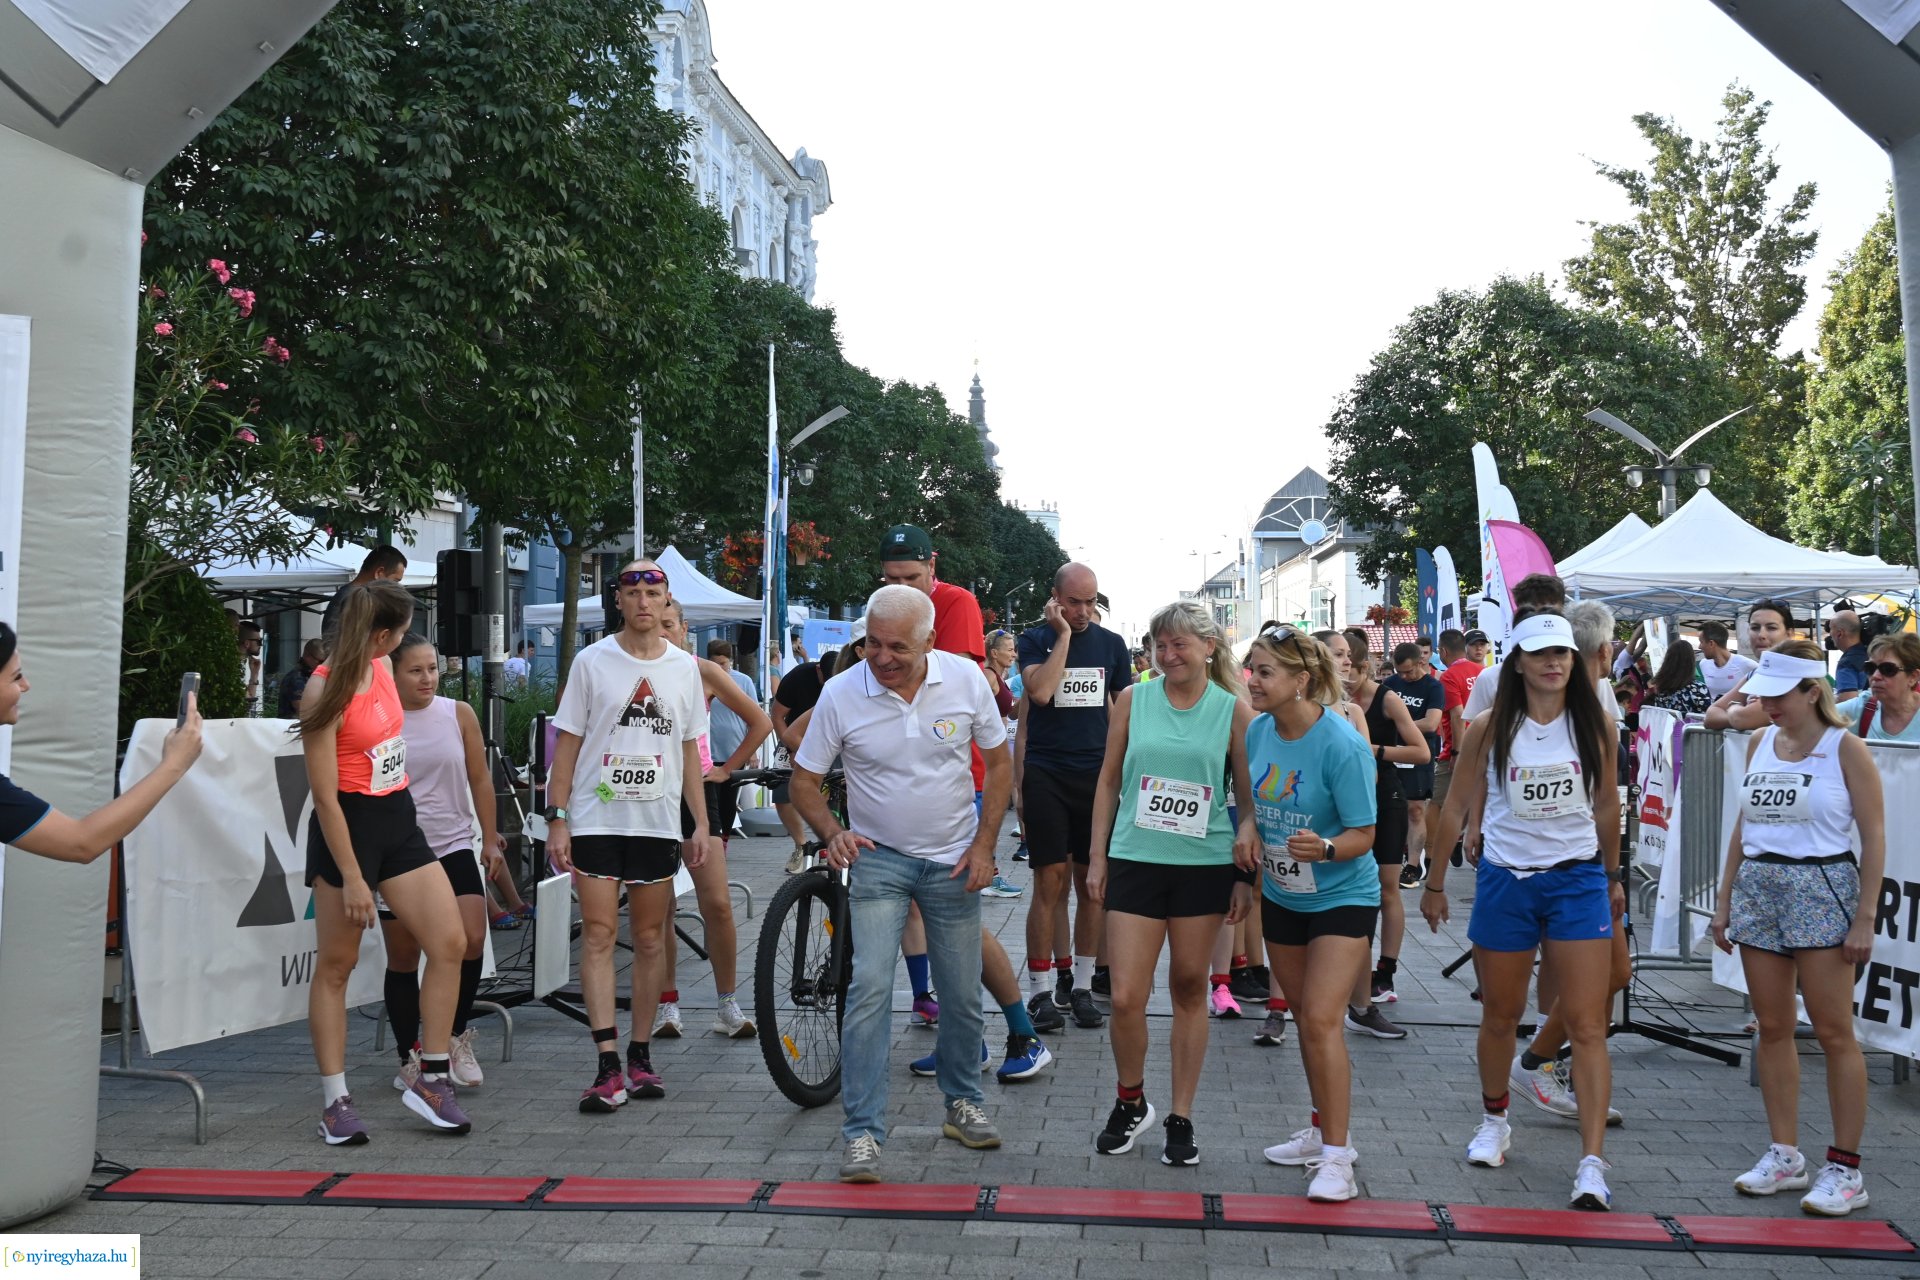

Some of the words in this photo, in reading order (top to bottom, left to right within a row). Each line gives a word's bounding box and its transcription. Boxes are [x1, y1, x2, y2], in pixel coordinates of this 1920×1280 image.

[1063, 681, 1098, 694] 5066
[611, 769, 656, 785] 5088
[1523, 778, 1574, 801] 5073
[1750, 788, 1797, 807] 5209
[1148, 794, 1199, 818] 5009
[1284, 810, 1313, 827] CITY
[281, 949, 318, 988] WI
